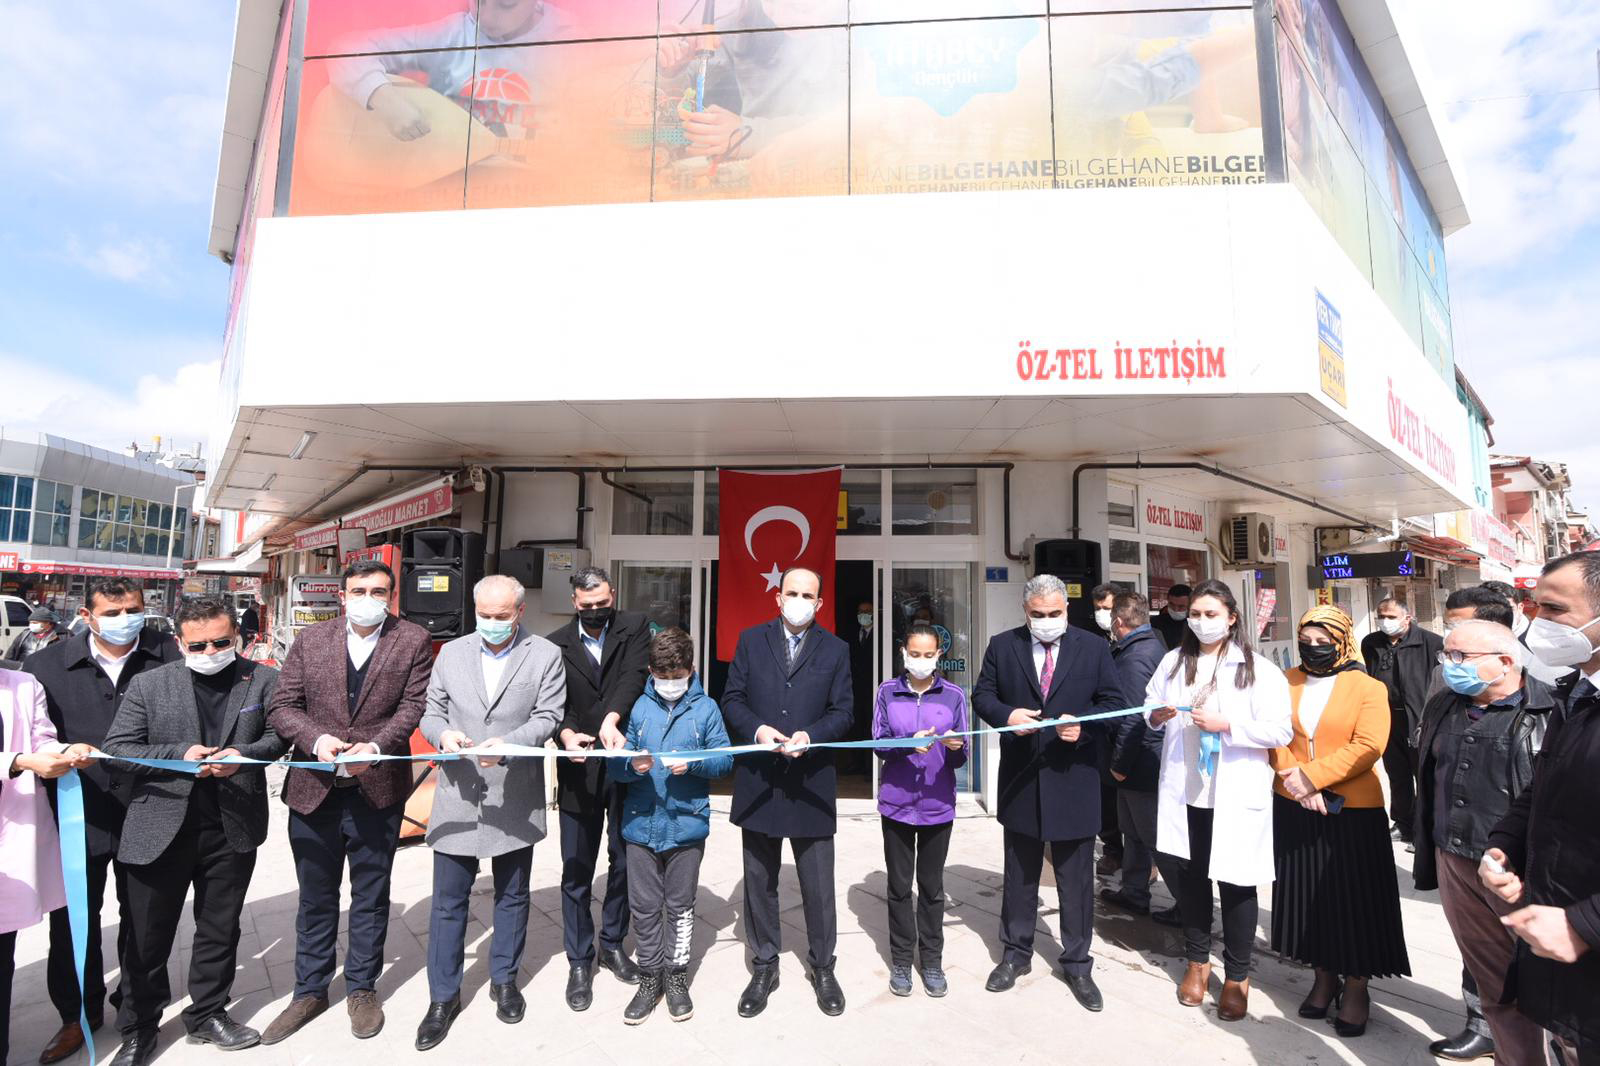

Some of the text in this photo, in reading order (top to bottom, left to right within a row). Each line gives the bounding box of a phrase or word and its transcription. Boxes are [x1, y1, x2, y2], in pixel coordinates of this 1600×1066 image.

[1016, 339, 1226, 385] ÖZ-TEL İLETİŞİM
[394, 498, 429, 522] MARKET
[1146, 498, 1172, 527] ÖZ-TEL
